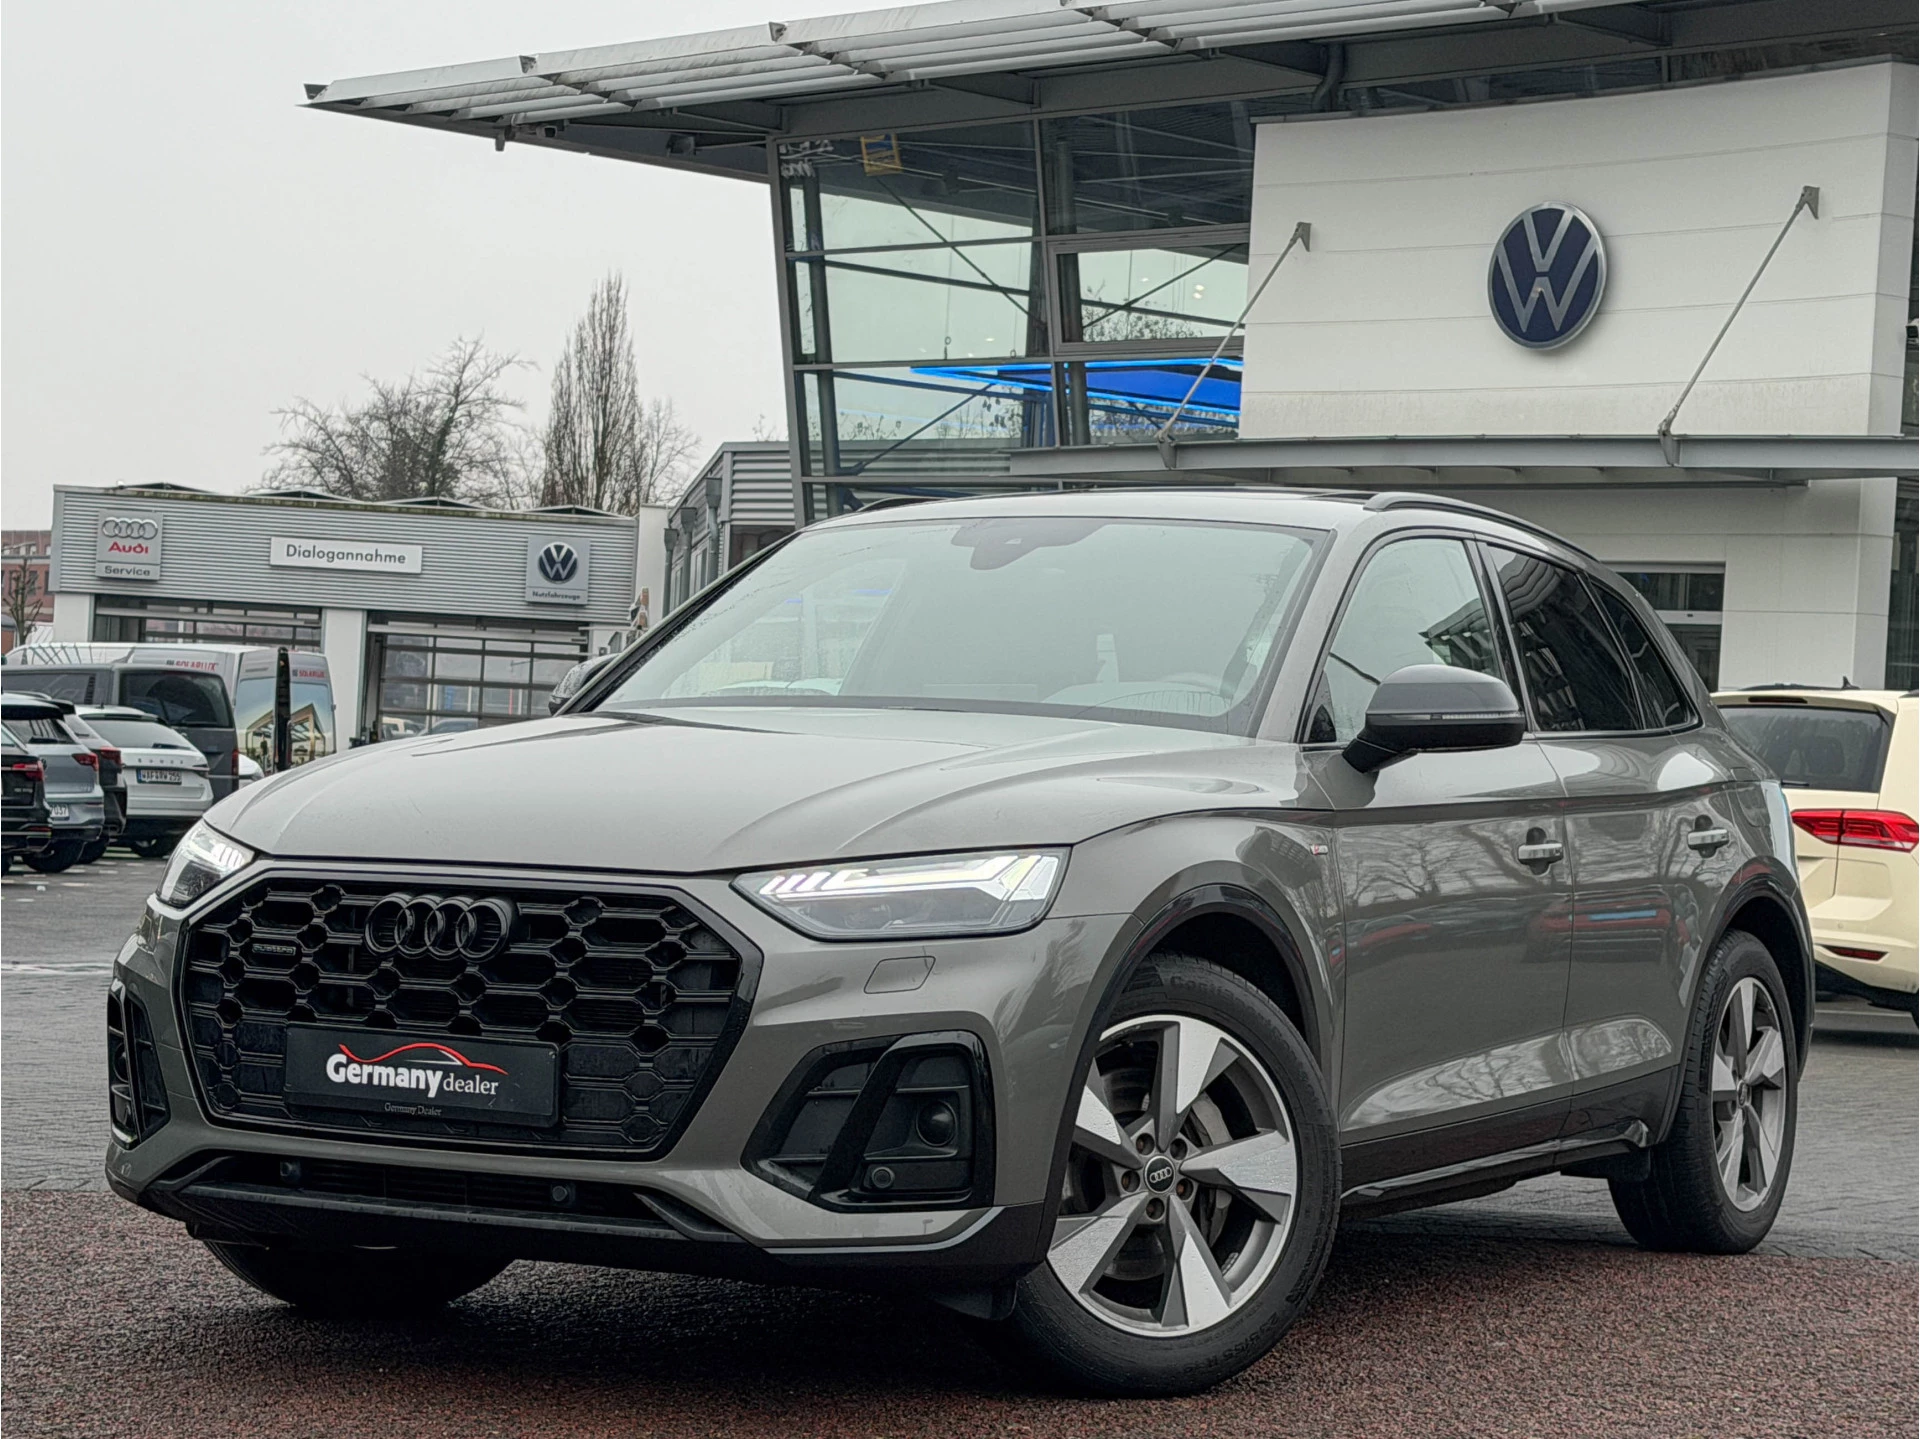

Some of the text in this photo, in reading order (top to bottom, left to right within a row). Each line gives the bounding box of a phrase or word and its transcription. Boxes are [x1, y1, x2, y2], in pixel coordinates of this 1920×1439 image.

[107, 541, 149, 554] Audi
[286, 543, 406, 563] Dialogannahme
[104, 565, 151, 577] Service
[326, 1053, 499, 1098] Germany dealer
[384, 1102, 442, 1116] Germany Dealer
